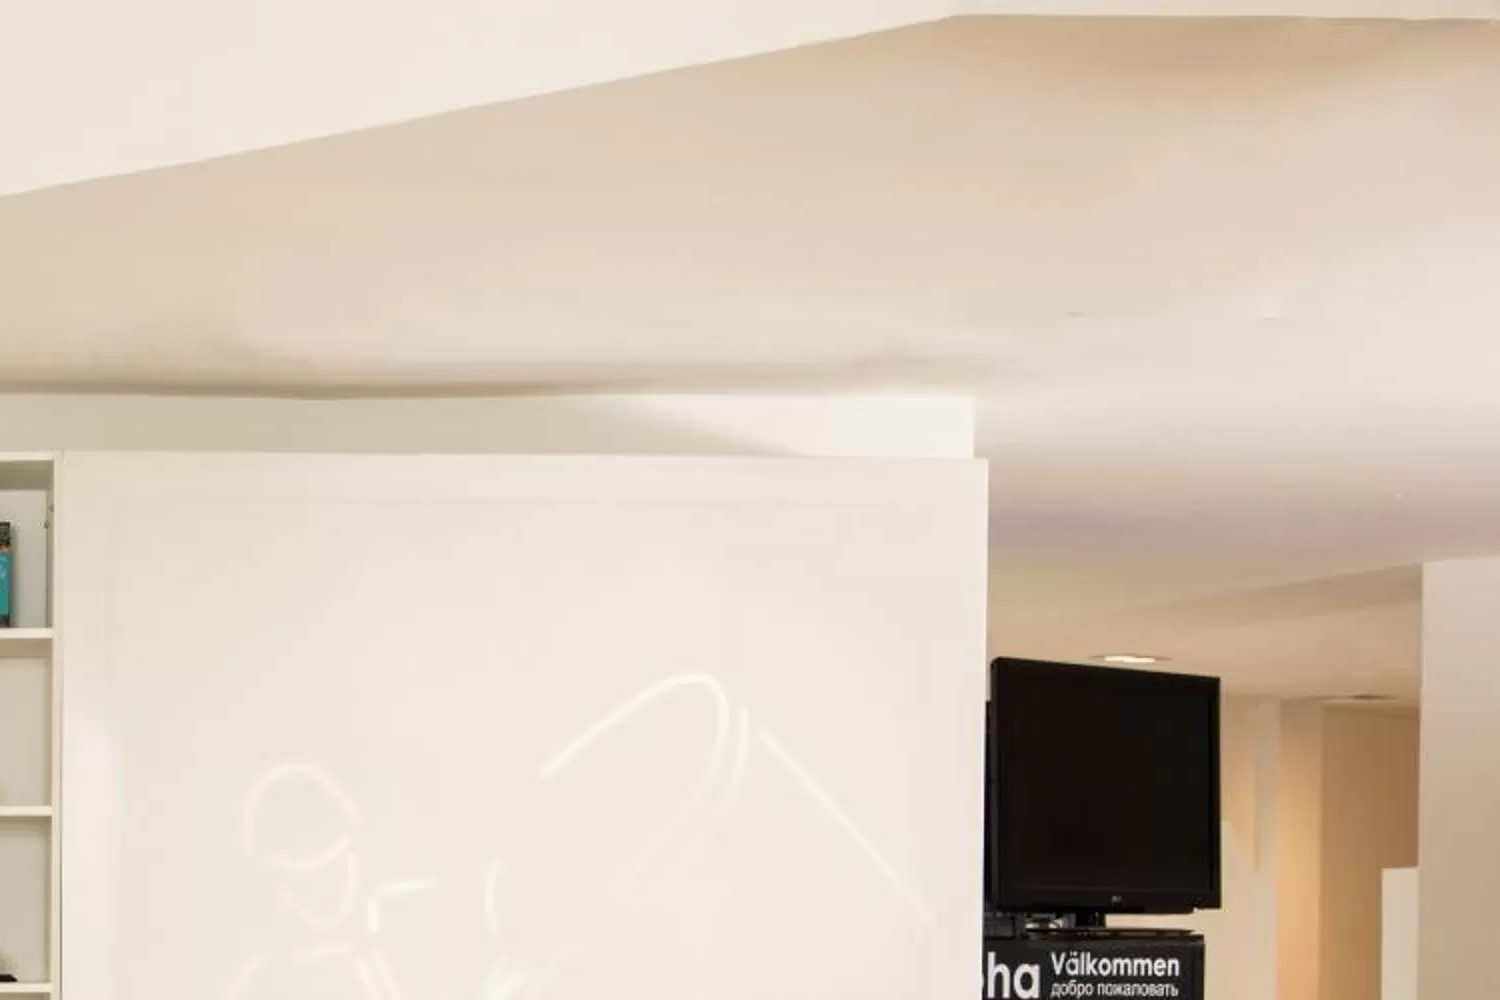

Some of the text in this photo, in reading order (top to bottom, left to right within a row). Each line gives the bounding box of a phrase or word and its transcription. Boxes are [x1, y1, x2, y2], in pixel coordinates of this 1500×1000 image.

[981, 952, 1041, 999] ha
[1051, 951, 1180, 977] Välkommen
[1050, 979, 1179, 998] добро пожаловать
